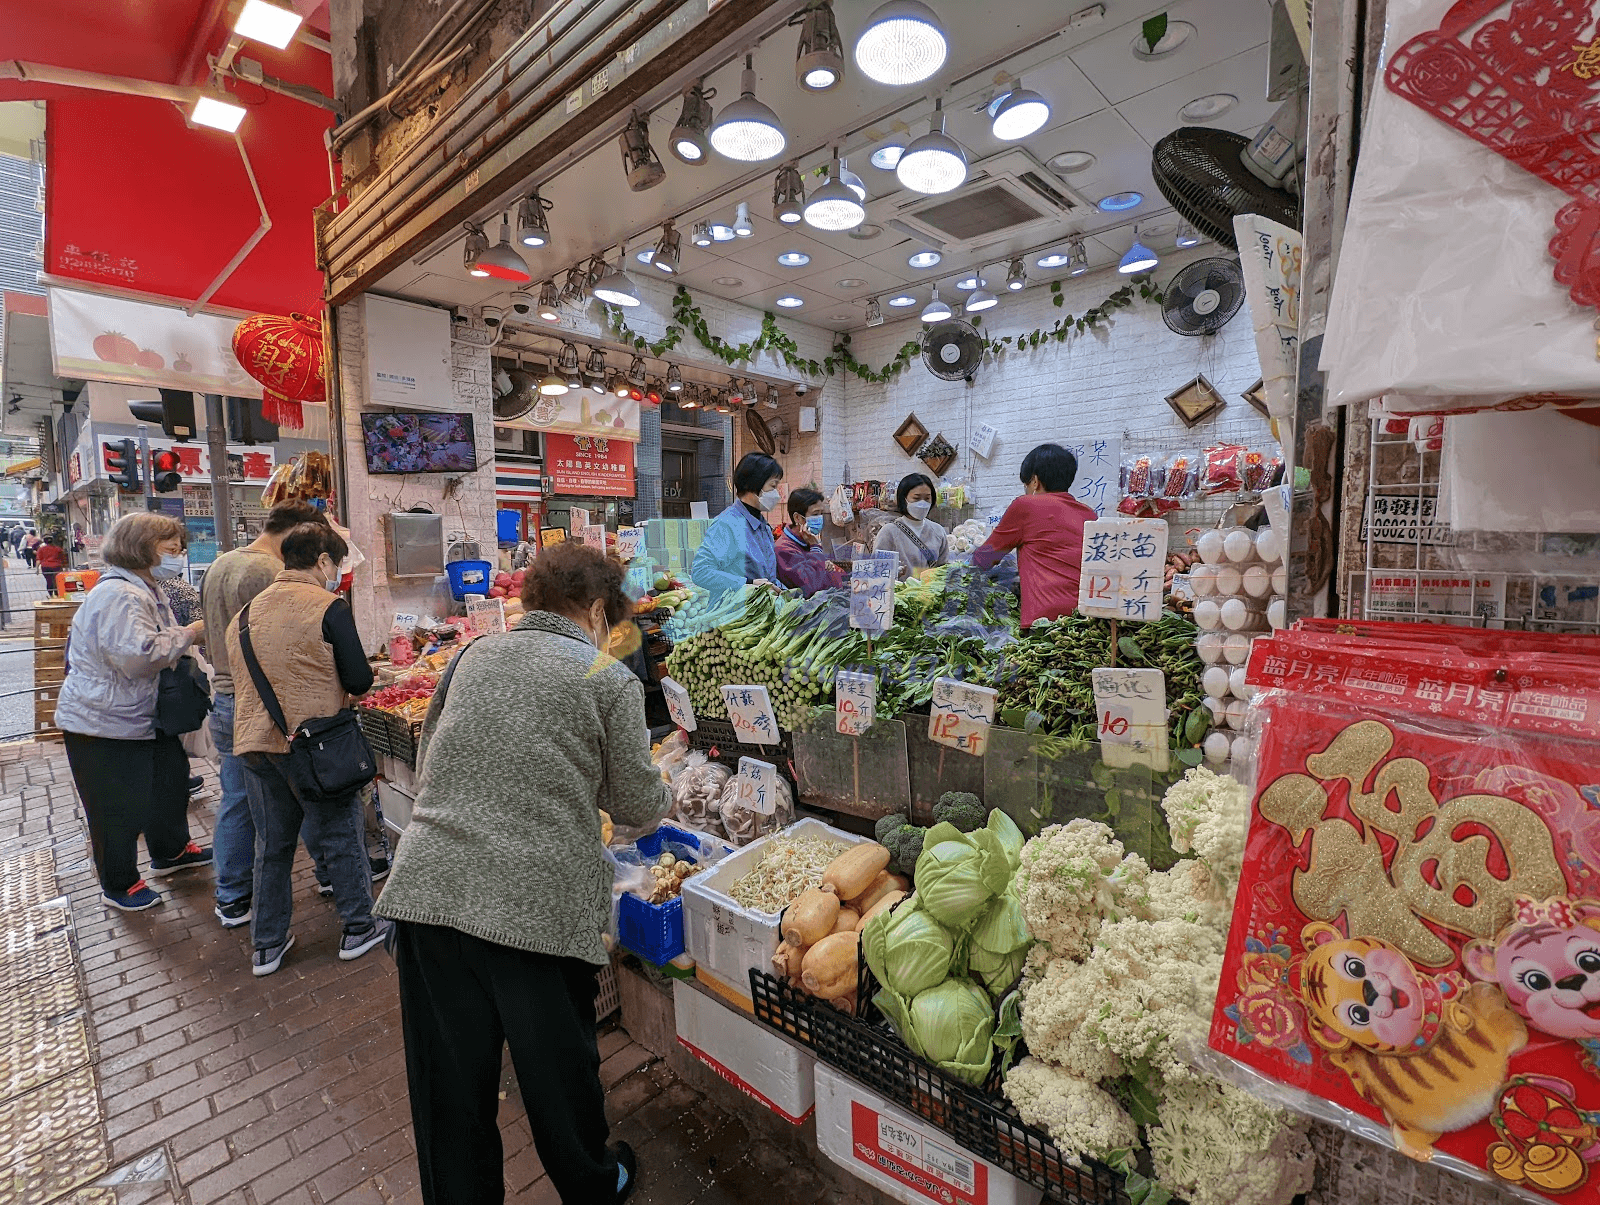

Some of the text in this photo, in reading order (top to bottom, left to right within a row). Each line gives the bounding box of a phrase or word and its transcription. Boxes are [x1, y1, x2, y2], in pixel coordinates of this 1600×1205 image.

[1088, 575, 1112, 600] 12
[1262, 655, 1341, 684] 蓝月亮
[1415, 678, 1505, 712] 蓝月亮
[933, 714, 959, 738] 12
[1101, 711, 1128, 736] 10
